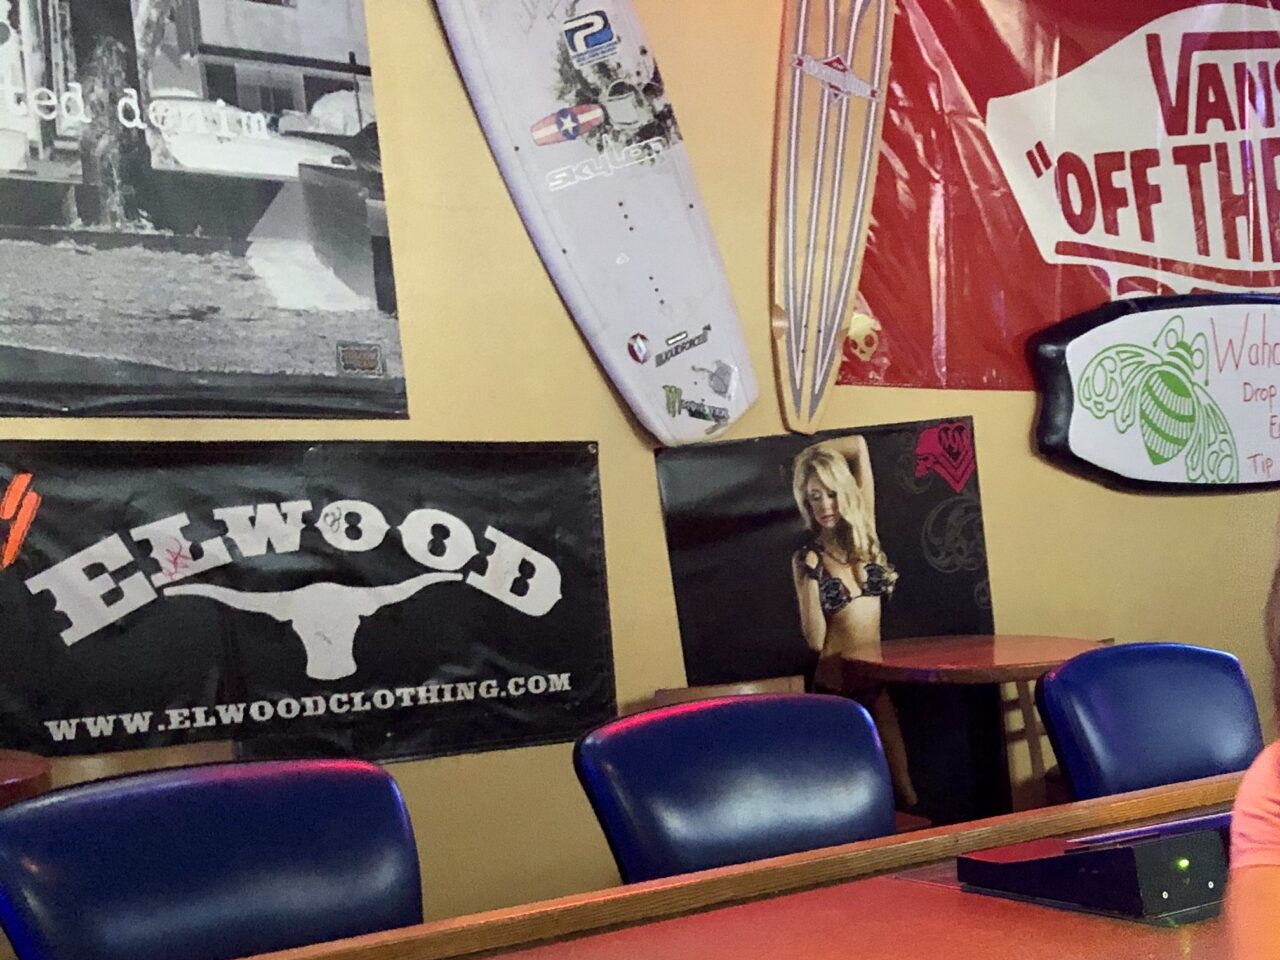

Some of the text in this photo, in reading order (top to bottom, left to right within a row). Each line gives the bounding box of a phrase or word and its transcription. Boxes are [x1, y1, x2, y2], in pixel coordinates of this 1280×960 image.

[1243, 381, 1277, 413] Drop
[1246, 452, 1274, 477] Tip
[24, 499, 564, 648] ELWOOD
[44, 671, 573, 742] WWW.ELWOODCLOTHING.COM
